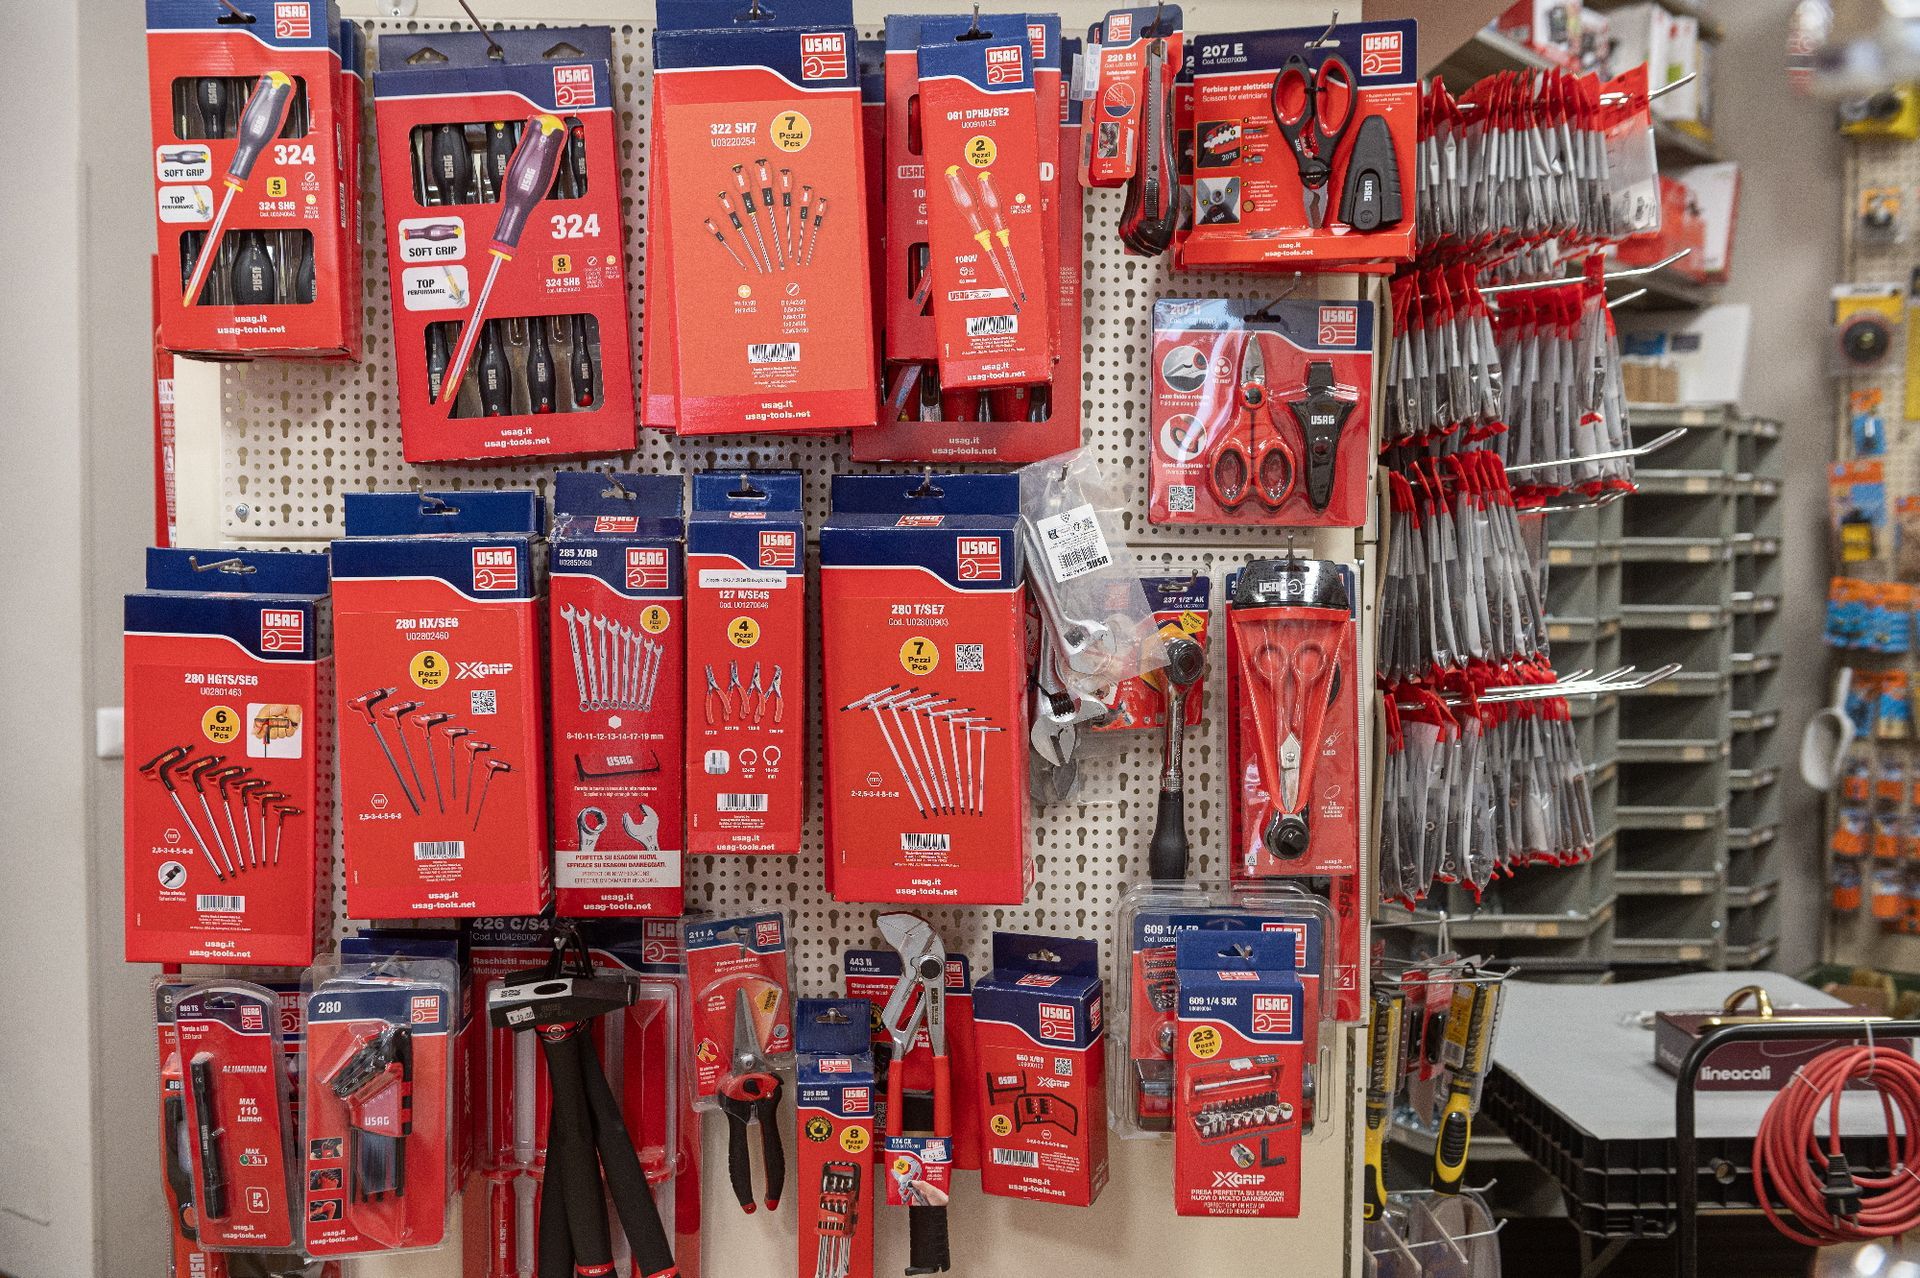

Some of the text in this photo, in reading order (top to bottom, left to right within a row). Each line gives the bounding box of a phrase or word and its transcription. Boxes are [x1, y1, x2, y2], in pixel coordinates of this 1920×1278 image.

[277, 6, 307, 18] USAG
[1111, 16, 1130, 26] USAG
[805, 38, 841, 52] USAG
[1366, 36, 1398, 51] USAG
[1202, 43, 1243, 58] 207 E
[989, 50, 1018, 62] USAG
[1107, 53, 1137, 62] 220 B1
[557, 69, 590, 82] USAG
[208, 83, 217, 104] USAG
[710, 122, 757, 134] 322 SH7
[784, 116, 796, 130] 7
[779, 132, 803, 140] Pezzi
[976, 140, 986, 151] 2
[274, 144, 316, 165] 324
[1222, 152, 1237, 161] 207E
[443, 154, 453, 178] USAG
[164, 168, 204, 177] SOFT GRIP
[273, 180, 281, 190] 5
[520, 168, 536, 192] USAG
[1364, 180, 1372, 201] USAG
[170, 196, 185, 204] TOP
[259, 202, 276, 210] 324
[551, 214, 600, 239] 324
[408, 246, 457, 257] SOFT GRIP
[557, 258, 566, 268] 8
[252, 266, 262, 291] USAG
[416, 279, 435, 288] TOP
[546, 279, 562, 287] 324
[407, 288, 446, 296] PERFORMANCE
[234, 315, 267, 324] usag.it
[1322, 310, 1354, 322] USAG
[217, 326, 286, 334] usag-tools.net
[982, 362, 1009, 371] usag.it
[967, 370, 1025, 381] usag-tools.net
[762, 400, 793, 409] usag.it
[745, 410, 810, 420] usag-tools.net
[1311, 415, 1335, 425] USAG
[501, 428, 532, 437] usag.it
[484, 437, 550, 448] usag-tools.net
[949, 436, 980, 445] usag.it
[932, 446, 997, 455] usag-tools.net
[762, 535, 792, 546] USAG
[559, 549, 598, 557] 285 X/B8
[962, 542, 996, 554] USAG
[477, 551, 512, 565] USAG
[630, 552, 664, 565] USAG
[718, 591, 735, 599] 127
[652, 610, 658, 619] 8
[891, 605, 944, 614] 280 T/SE7
[265, 614, 299, 627] USAG
[396, 618, 458, 629] 280 HX/SE6
[888, 618, 904, 626] Cod.
[739, 621, 749, 631] 4
[914, 642, 924, 655] 7
[424, 656, 434, 668] 6
[455, 662, 513, 679] XGRIP
[184, 674, 258, 686] 280 HGTS/SE6
[216, 711, 227, 723] 6
[606, 755, 633, 766] USAG
[912, 878, 941, 886] usag.it
[428, 892, 458, 900] usag.it
[412, 901, 475, 910] usag-tools.net
[473, 918, 549, 930] 426 C/S4
[758, 923, 777, 932] USAG
[1144, 925, 1164, 934] 609
[205, 941, 235, 949] usag.it
[189, 950, 251, 958] usag-tools.net
[849, 958, 864, 966] 443
[414, 999, 436, 1008] USAG
[1189, 997, 1237, 1005] 609 1/4 SKX
[1257, 998, 1288, 1010] USAG
[243, 1007, 260, 1016] USAG
[318, 1002, 341, 1013] 280
[1042, 1007, 1071, 1020] USAG
[1192, 1030, 1214, 1040] 23
[222, 1065, 267, 1073] ALUMINIUM
[1701, 1066, 1771, 1081] lineacali
[846, 1090, 866, 1098] USAG
[240, 1107, 258, 1115] 110
[365, 1116, 389, 1125] USAG
[850, 1129, 858, 1138] 8
[1023, 1176, 1050, 1186] usag.it
[1211, 1171, 1266, 1188] XGRIP
[1008, 1184, 1066, 1196] usag-tools.net
[252, 1200, 263, 1208] 54
